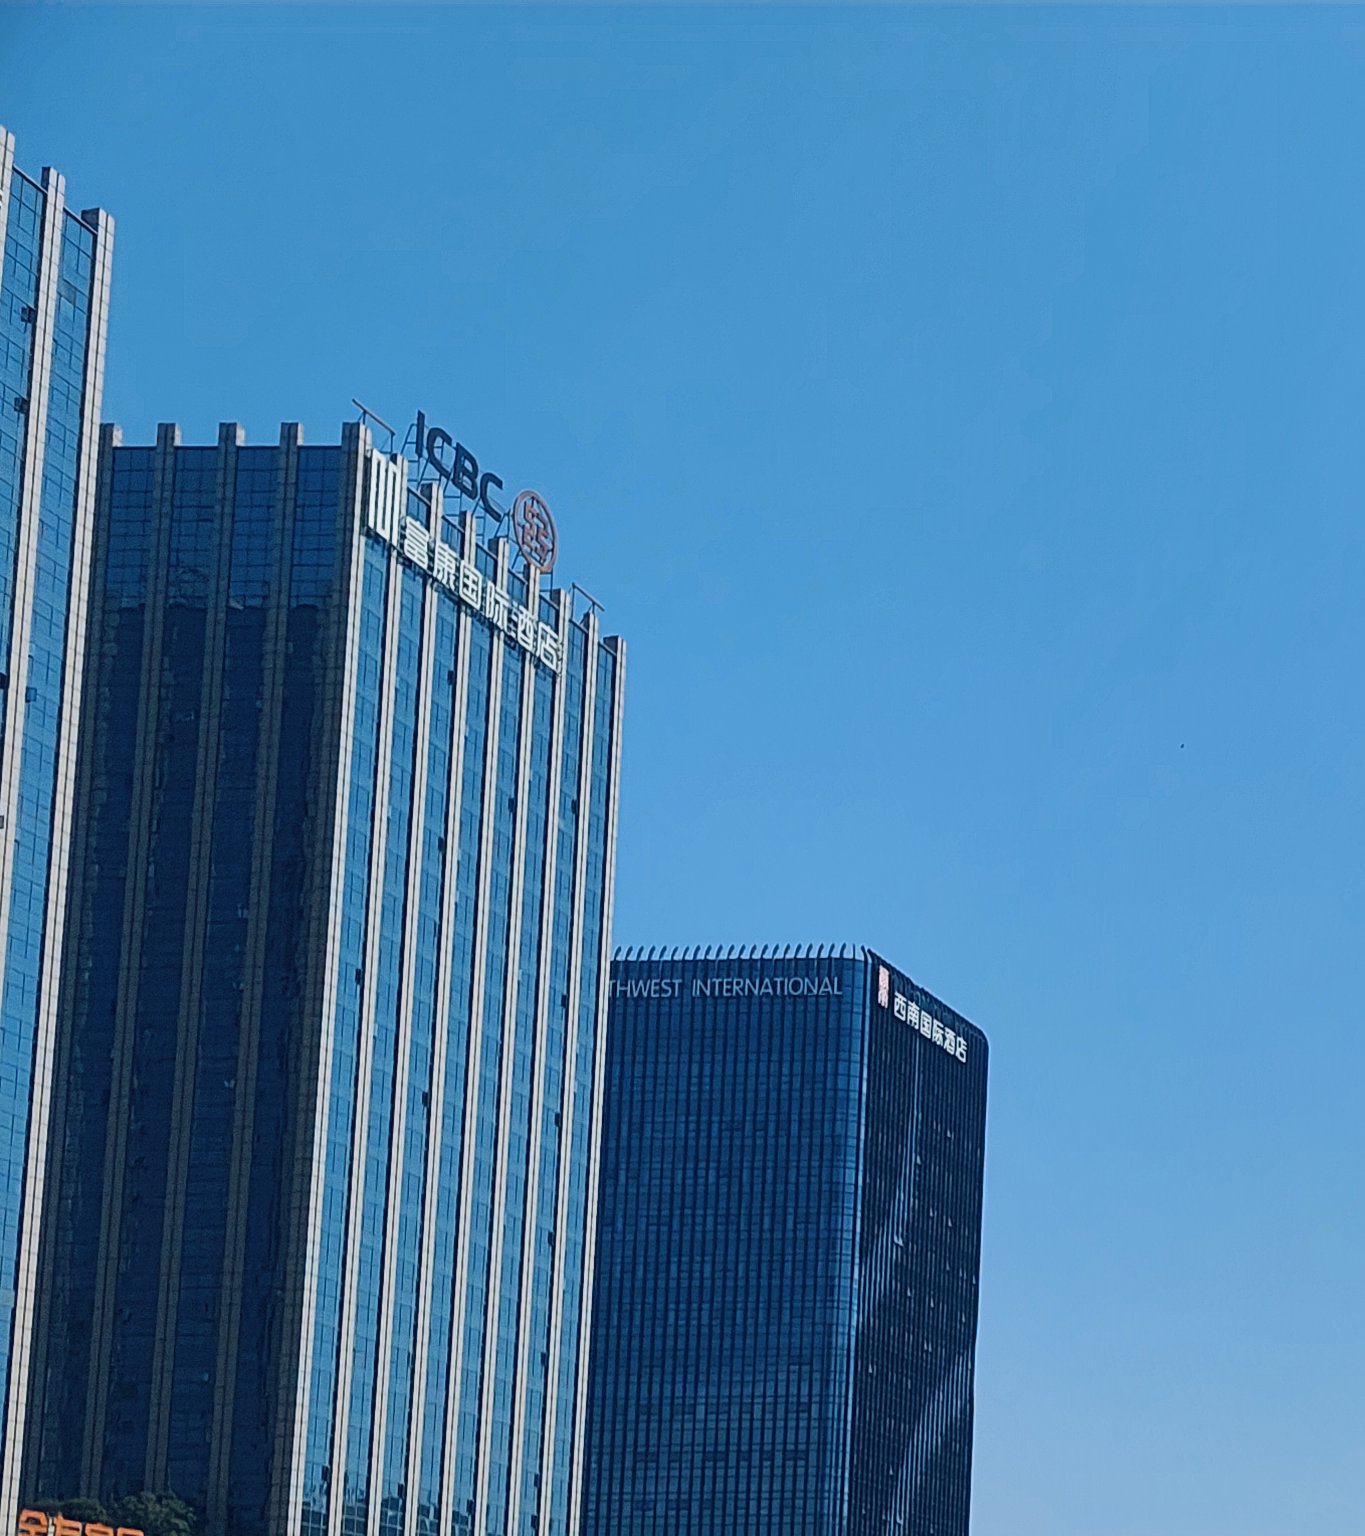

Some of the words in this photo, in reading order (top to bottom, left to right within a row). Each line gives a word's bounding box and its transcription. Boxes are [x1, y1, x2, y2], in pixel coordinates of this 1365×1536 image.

[416, 410, 503, 522] ICBC
[404, 515, 564, 674] 富康国际酒店
[692, 976, 843, 997] INTERNATIONAL
[894, 991, 967, 1063] 西南国际酒店
